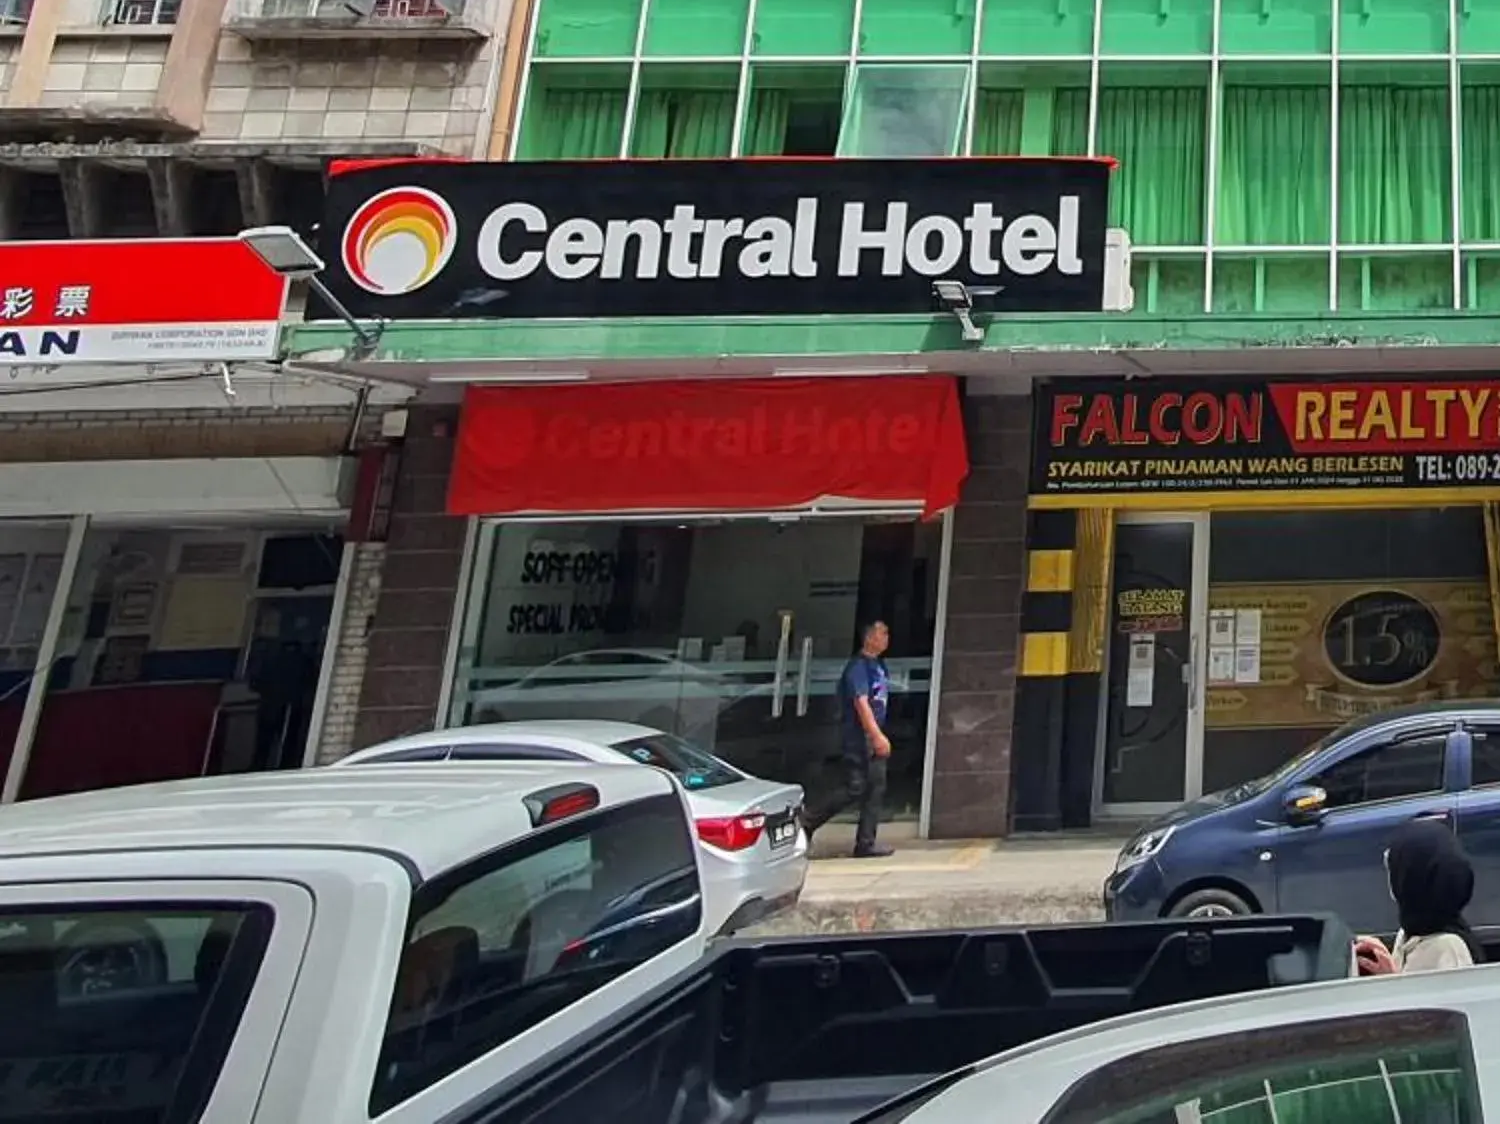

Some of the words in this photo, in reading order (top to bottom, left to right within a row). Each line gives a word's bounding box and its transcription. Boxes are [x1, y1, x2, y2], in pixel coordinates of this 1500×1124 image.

[477, 198, 817, 280] Central
[837, 195, 1083, 276] Hotel
[0, 285, 91, 318] 彩票
[1051, 392, 1263, 446] FALCON
[1295, 389, 1491, 440] REALTY
[1048, 459, 1141, 477] SYARIKAT
[1144, 458, 1243, 475] PINJAMAN
[1247, 458, 1307, 474] WANG
[1312, 456, 1404, 472] BERLESEN
[1416, 457, 1451, 480] TEL:
[1335, 614, 1429, 668] 1.5%
